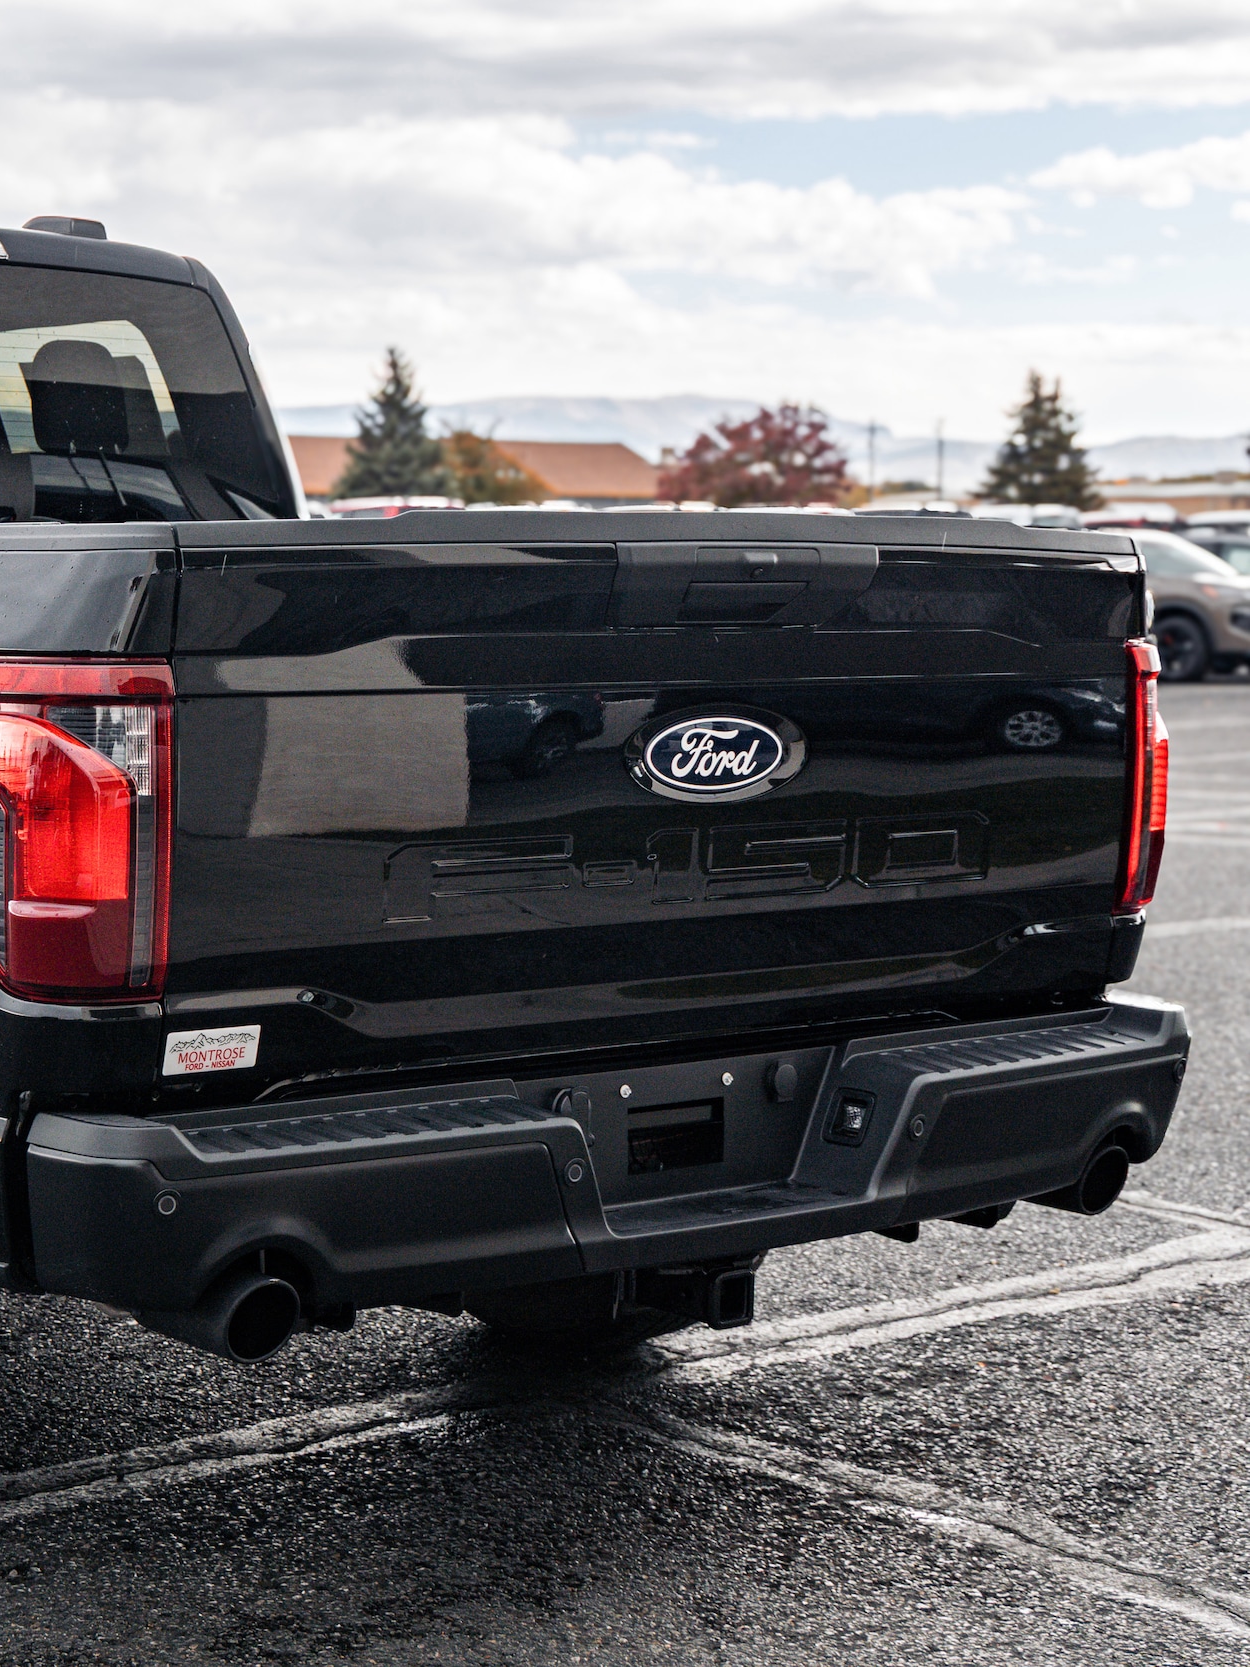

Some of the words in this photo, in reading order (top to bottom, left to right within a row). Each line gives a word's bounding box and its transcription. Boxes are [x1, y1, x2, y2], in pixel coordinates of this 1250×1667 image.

[671, 728, 760, 777] Ford
[383, 810, 989, 924] F-150
[178, 1047, 245, 1064] MONTROSE
[185, 1062, 203, 1071] FORD
[211, 1060, 235, 1069] NISSAN
